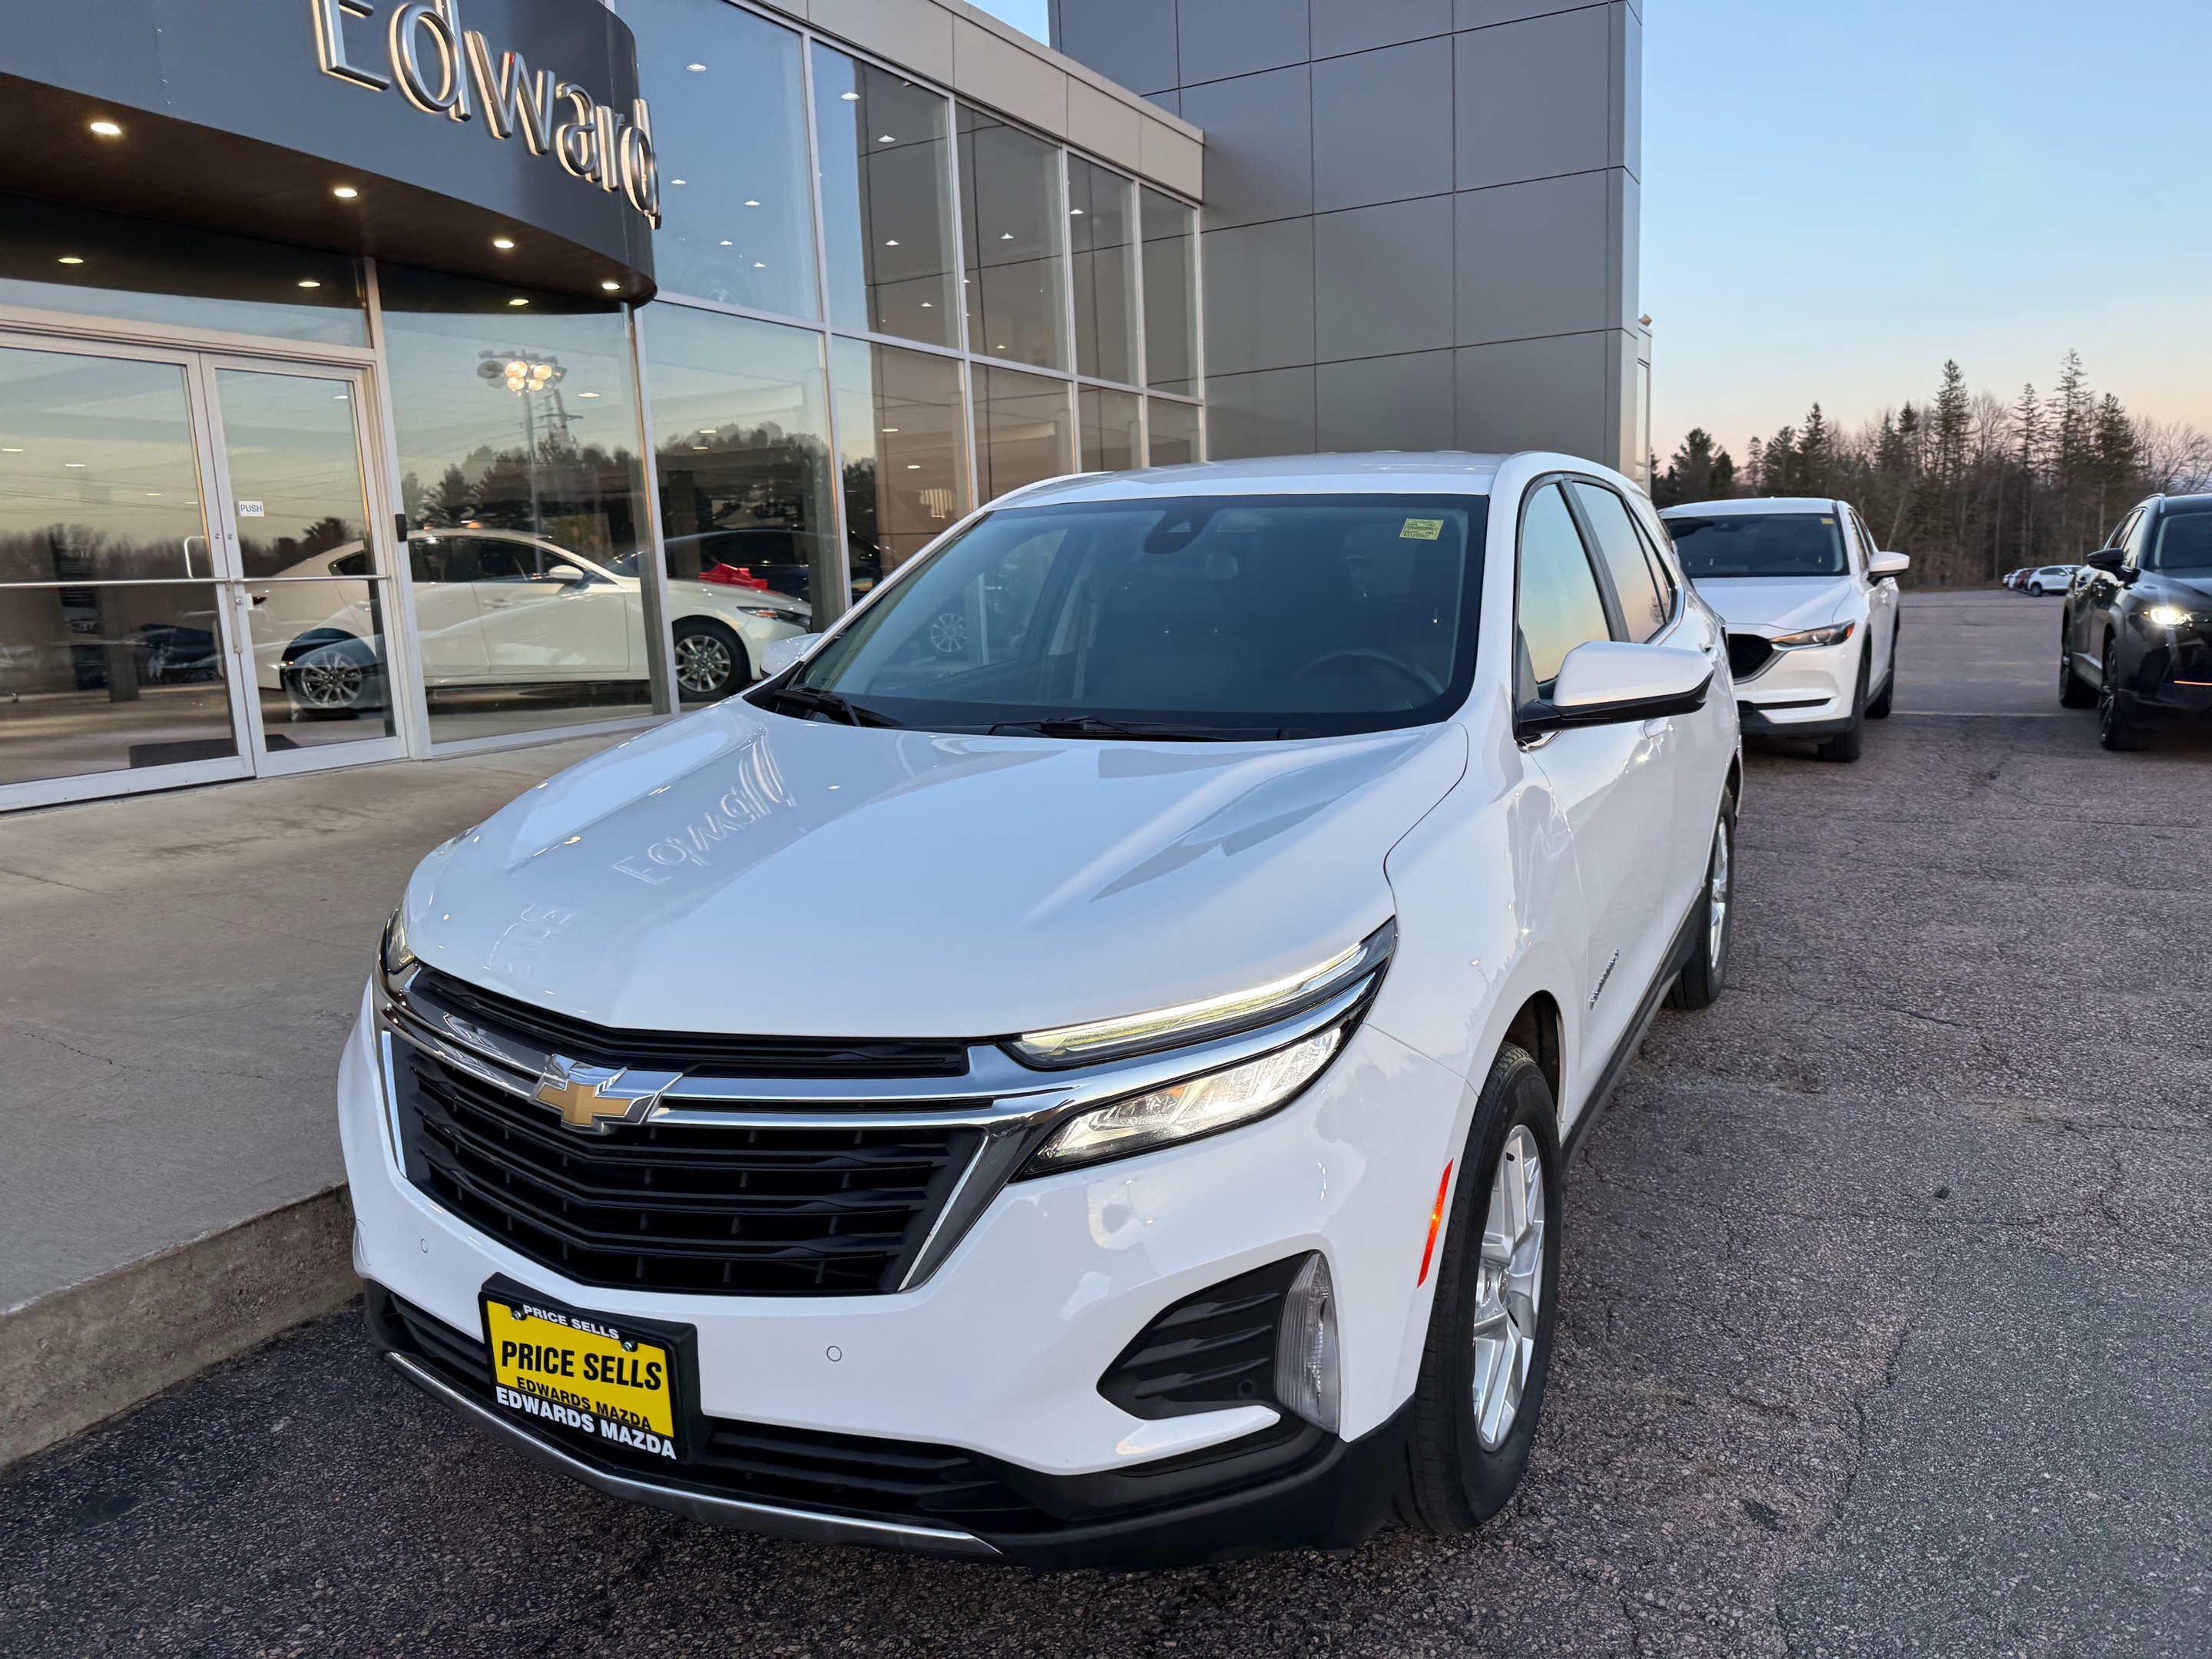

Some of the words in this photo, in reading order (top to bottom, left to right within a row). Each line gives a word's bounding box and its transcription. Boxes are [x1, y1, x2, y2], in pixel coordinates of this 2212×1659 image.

[240, 504, 263, 512] PUSH
[522, 1304, 568, 1326] PRICE
[571, 1318, 620, 1340] SELLS
[502, 1340, 575, 1378] PRICE
[584, 1353, 662, 1391] SELLS
[495, 1386, 595, 1433] EDWARDS
[601, 1419, 677, 1460] MAZDA
[516, 1376, 591, 1410] EDWARDS
[596, 1401, 652, 1431] MAZDA
